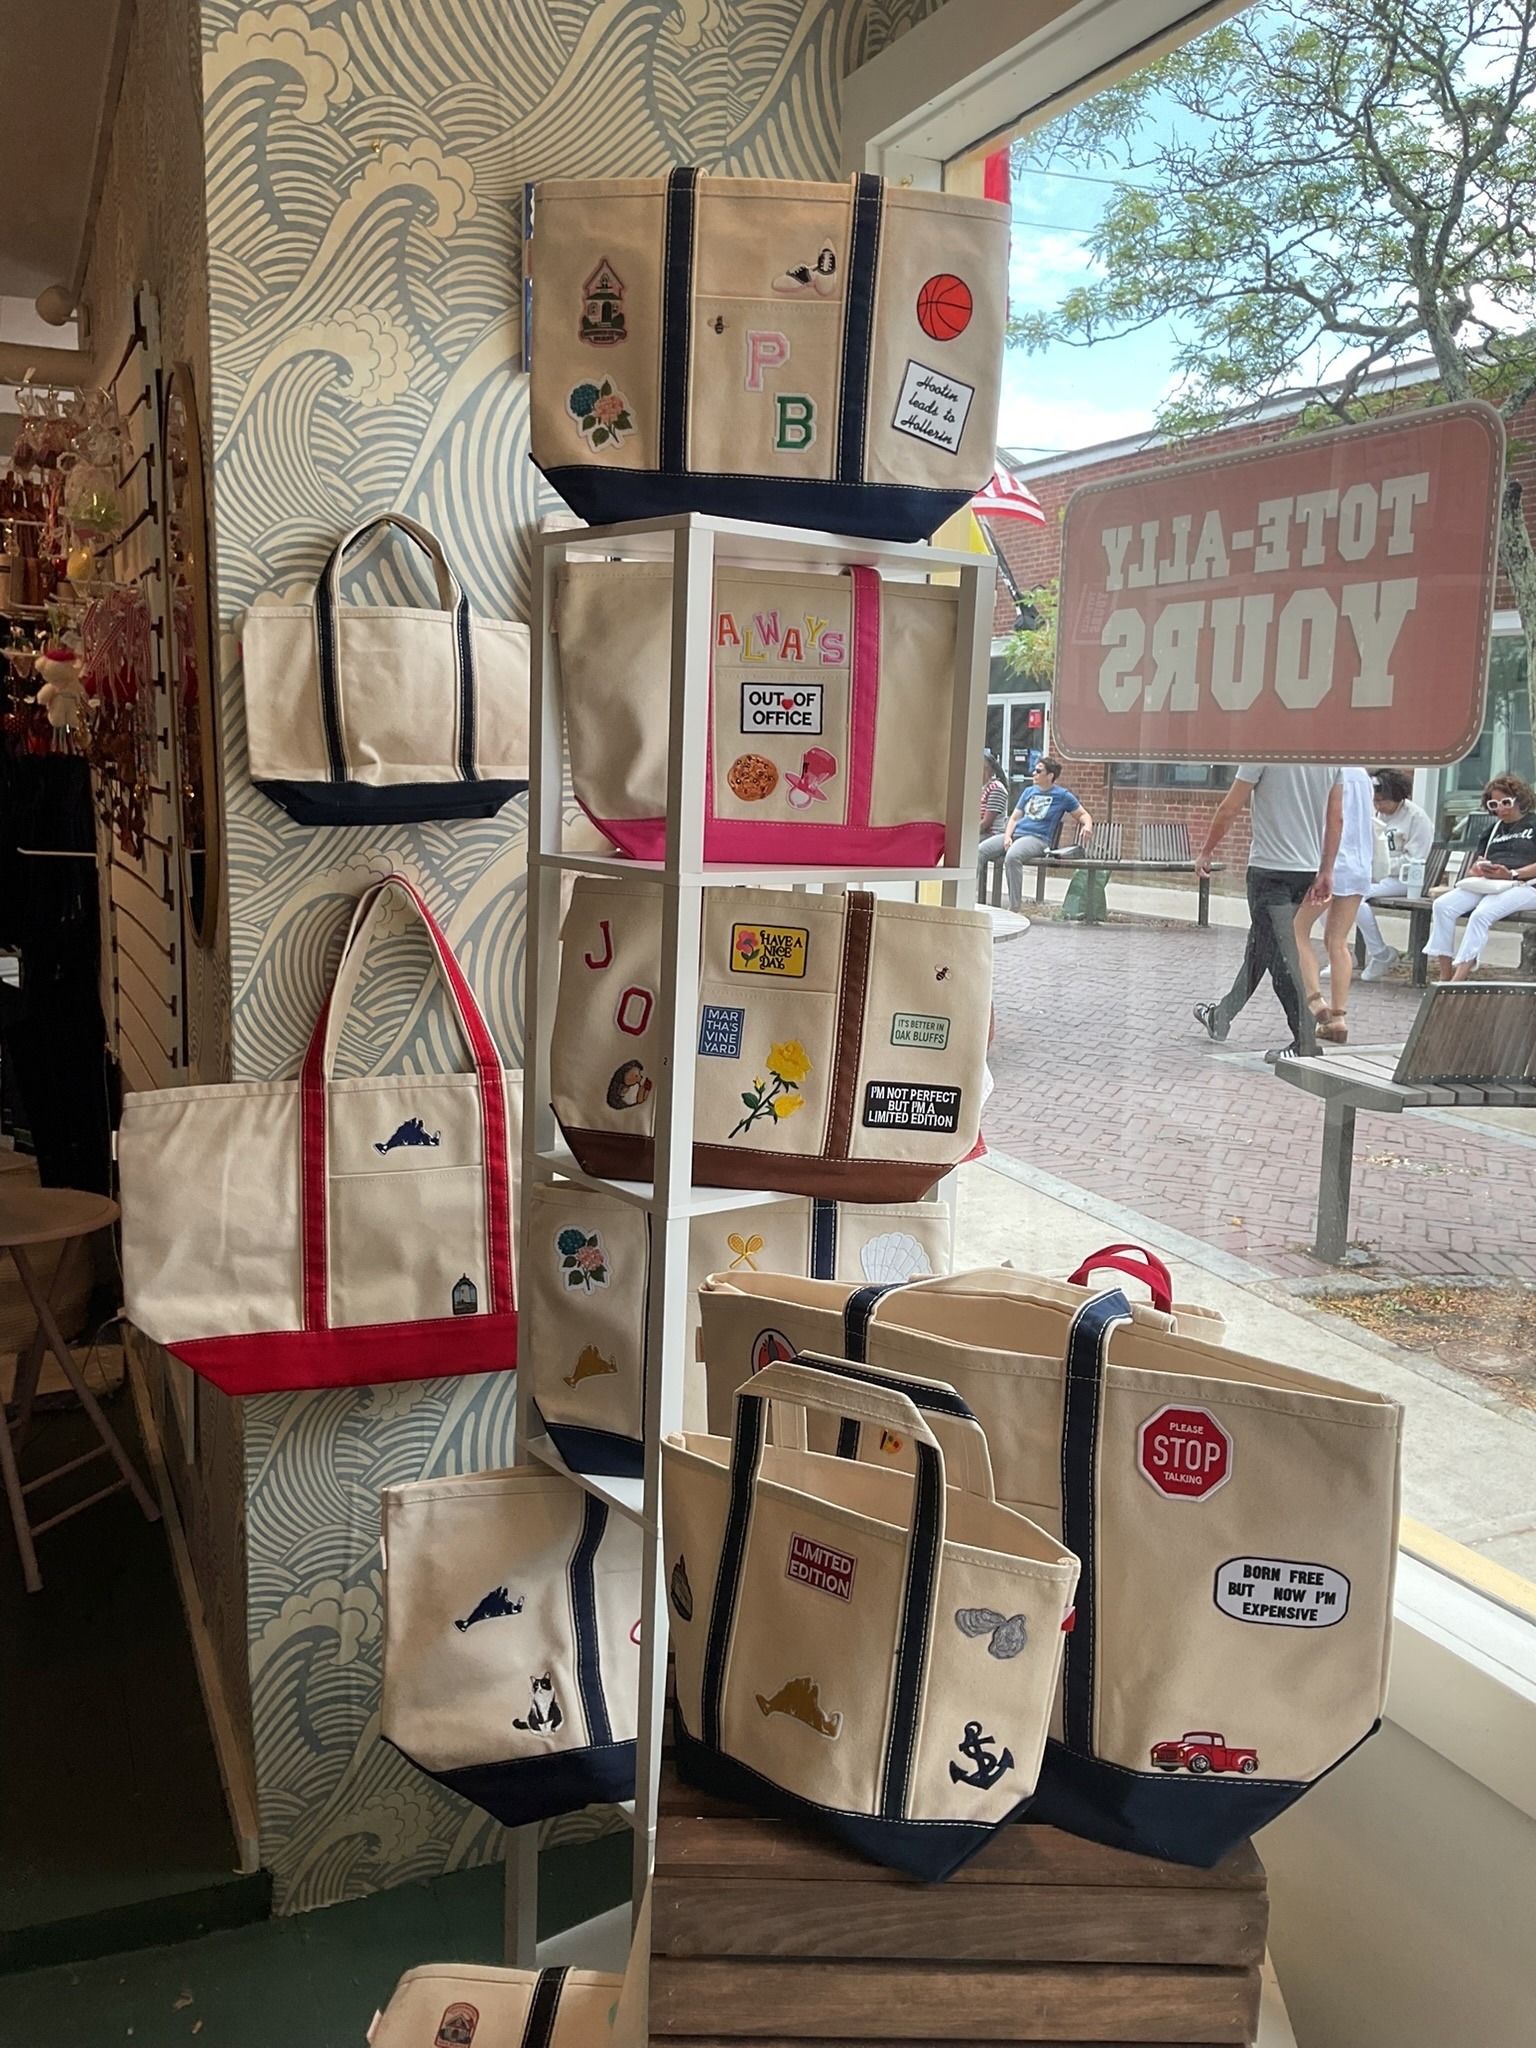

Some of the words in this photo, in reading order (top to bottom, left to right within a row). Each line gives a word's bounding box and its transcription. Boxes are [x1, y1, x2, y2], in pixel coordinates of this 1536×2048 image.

[746, 331, 789, 391] P
[916, 376, 959, 402] Hootin
[908, 391, 939, 416] leads
[943, 408, 956, 423] to
[775, 393, 816, 452] B
[900, 414, 952, 444] Hollerin
[717, 611, 846, 663] ALWAYS
[749, 691, 785, 706] OUT
[793, 692, 816, 707] OF
[752, 710, 812, 726] OFFICE
[584, 920, 613, 970] J
[760, 930, 793, 947] HAVE
[793, 937, 803, 948] A
[763, 945, 792, 958] NICE
[759, 956, 785, 970] DAY
[616, 986, 653, 1037] O
[709, 1009, 739, 1021] MAR
[706, 1020, 739, 1032] THA'S
[898, 1019, 910, 1028] IT'S
[910, 1020, 936, 1030] BETTER
[936, 1023, 945, 1031] IN
[705, 1030, 737, 1044] VINE
[895, 1029, 911, 1040] OAK
[913, 1031, 945, 1044] BLUFFS
[704, 1041, 737, 1054] YARD
[870, 1086, 885, 1099] I'M
[886, 1087, 909, 1100] NOT
[909, 1088, 958, 1104] PERFECT
[888, 1100, 910, 1112] BUT
[911, 1101, 926, 1114] I'M
[926, 1103, 936, 1114] A
[868, 1110, 909, 1124] LIMITED
[910, 1113, 953, 1127] EDITION
[1169, 1422, 1204, 1435] PLEASE
[1152, 1434, 1221, 1472] STOP
[1163, 1471, 1203, 1485] TALKING
[793, 1539, 851, 1575] LIMITED
[789, 1559, 849, 1598] EDITION
[1243, 1564, 1281, 1581] BORN
[1289, 1569, 1325, 1586] FREE
[1228, 1581, 1255, 1597] BUT
[1273, 1587, 1307, 1603] NOW
[1315, 1591, 1336, 1605] I'M
[1242, 1602, 1318, 1621] EXPENSIVE
